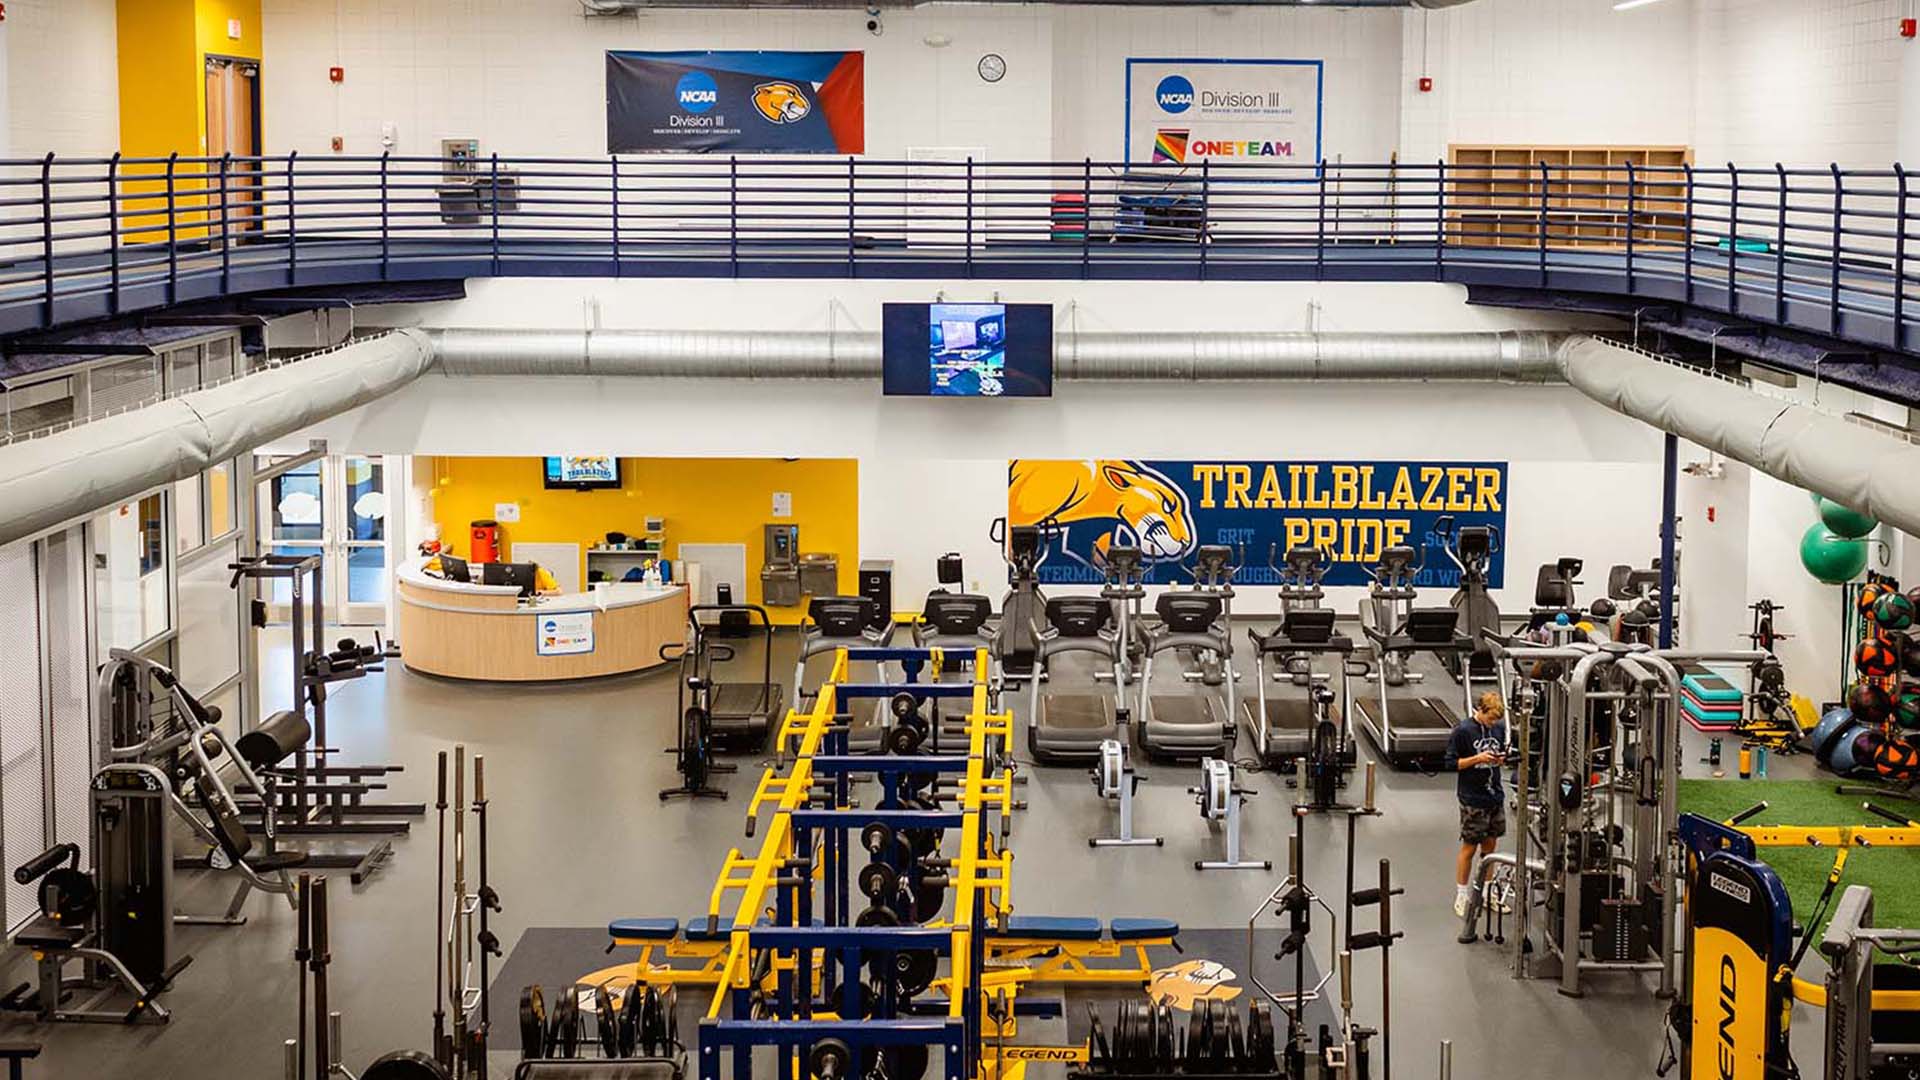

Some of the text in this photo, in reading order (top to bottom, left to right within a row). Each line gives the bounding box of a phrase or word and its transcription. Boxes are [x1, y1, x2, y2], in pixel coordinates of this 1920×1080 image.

[680, 90, 717, 103] NCAA
[1160, 93, 1193, 105] NCAA
[1201, 91, 1280, 108] Division III
[670, 115, 713, 127] Division
[1192, 140, 1293, 156] ONETEAM
[1193, 464, 1502, 512] TRAILBLAZER
[1217, 528, 1255, 545] GRIT
[1283, 517, 1411, 562] PRIDE
[1718, 953, 1737, 1080] END
[1003, 1048, 1078, 1060] EGEND
